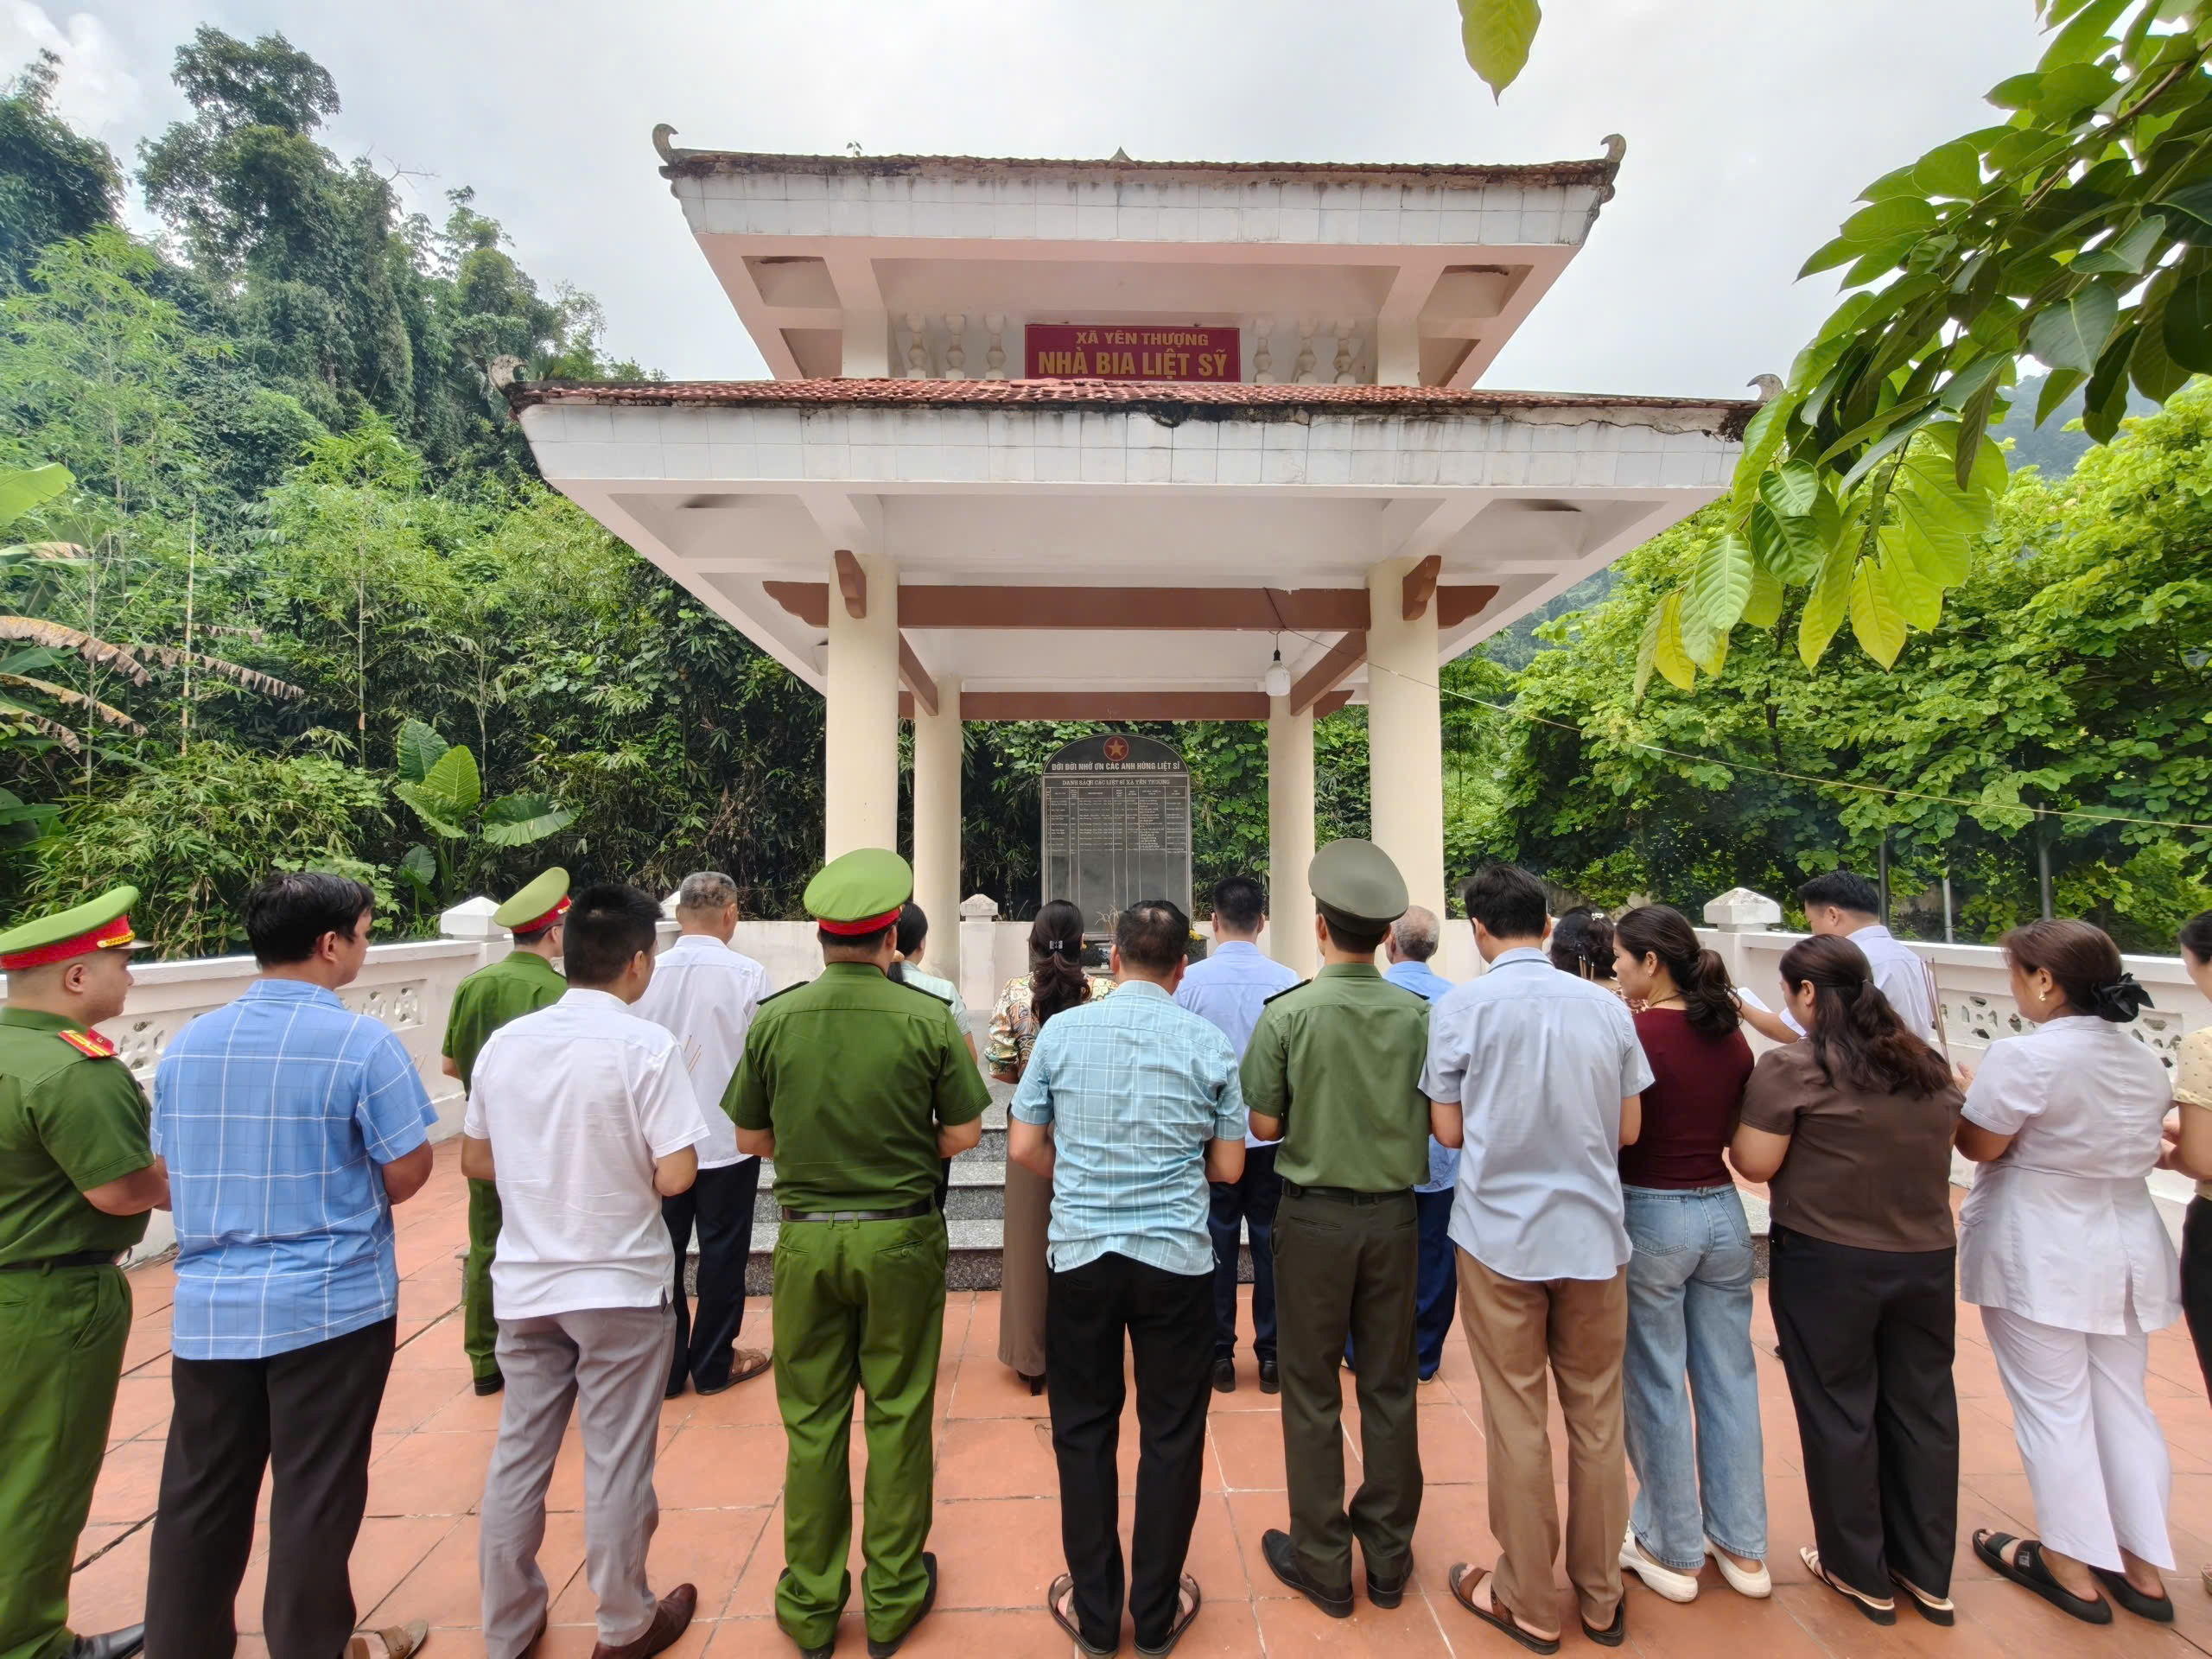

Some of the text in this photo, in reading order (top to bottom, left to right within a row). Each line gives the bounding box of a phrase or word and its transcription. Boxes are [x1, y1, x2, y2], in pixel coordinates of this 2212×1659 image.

[1076, 329, 1209, 347] XÃ YÊN THƯỢNG
[1039, 346, 1227, 380] NHÀ BIA LIỆT SỸ
[1106, 761, 1119, 770] CÁC
[1157, 760, 1172, 772] LIỆT
